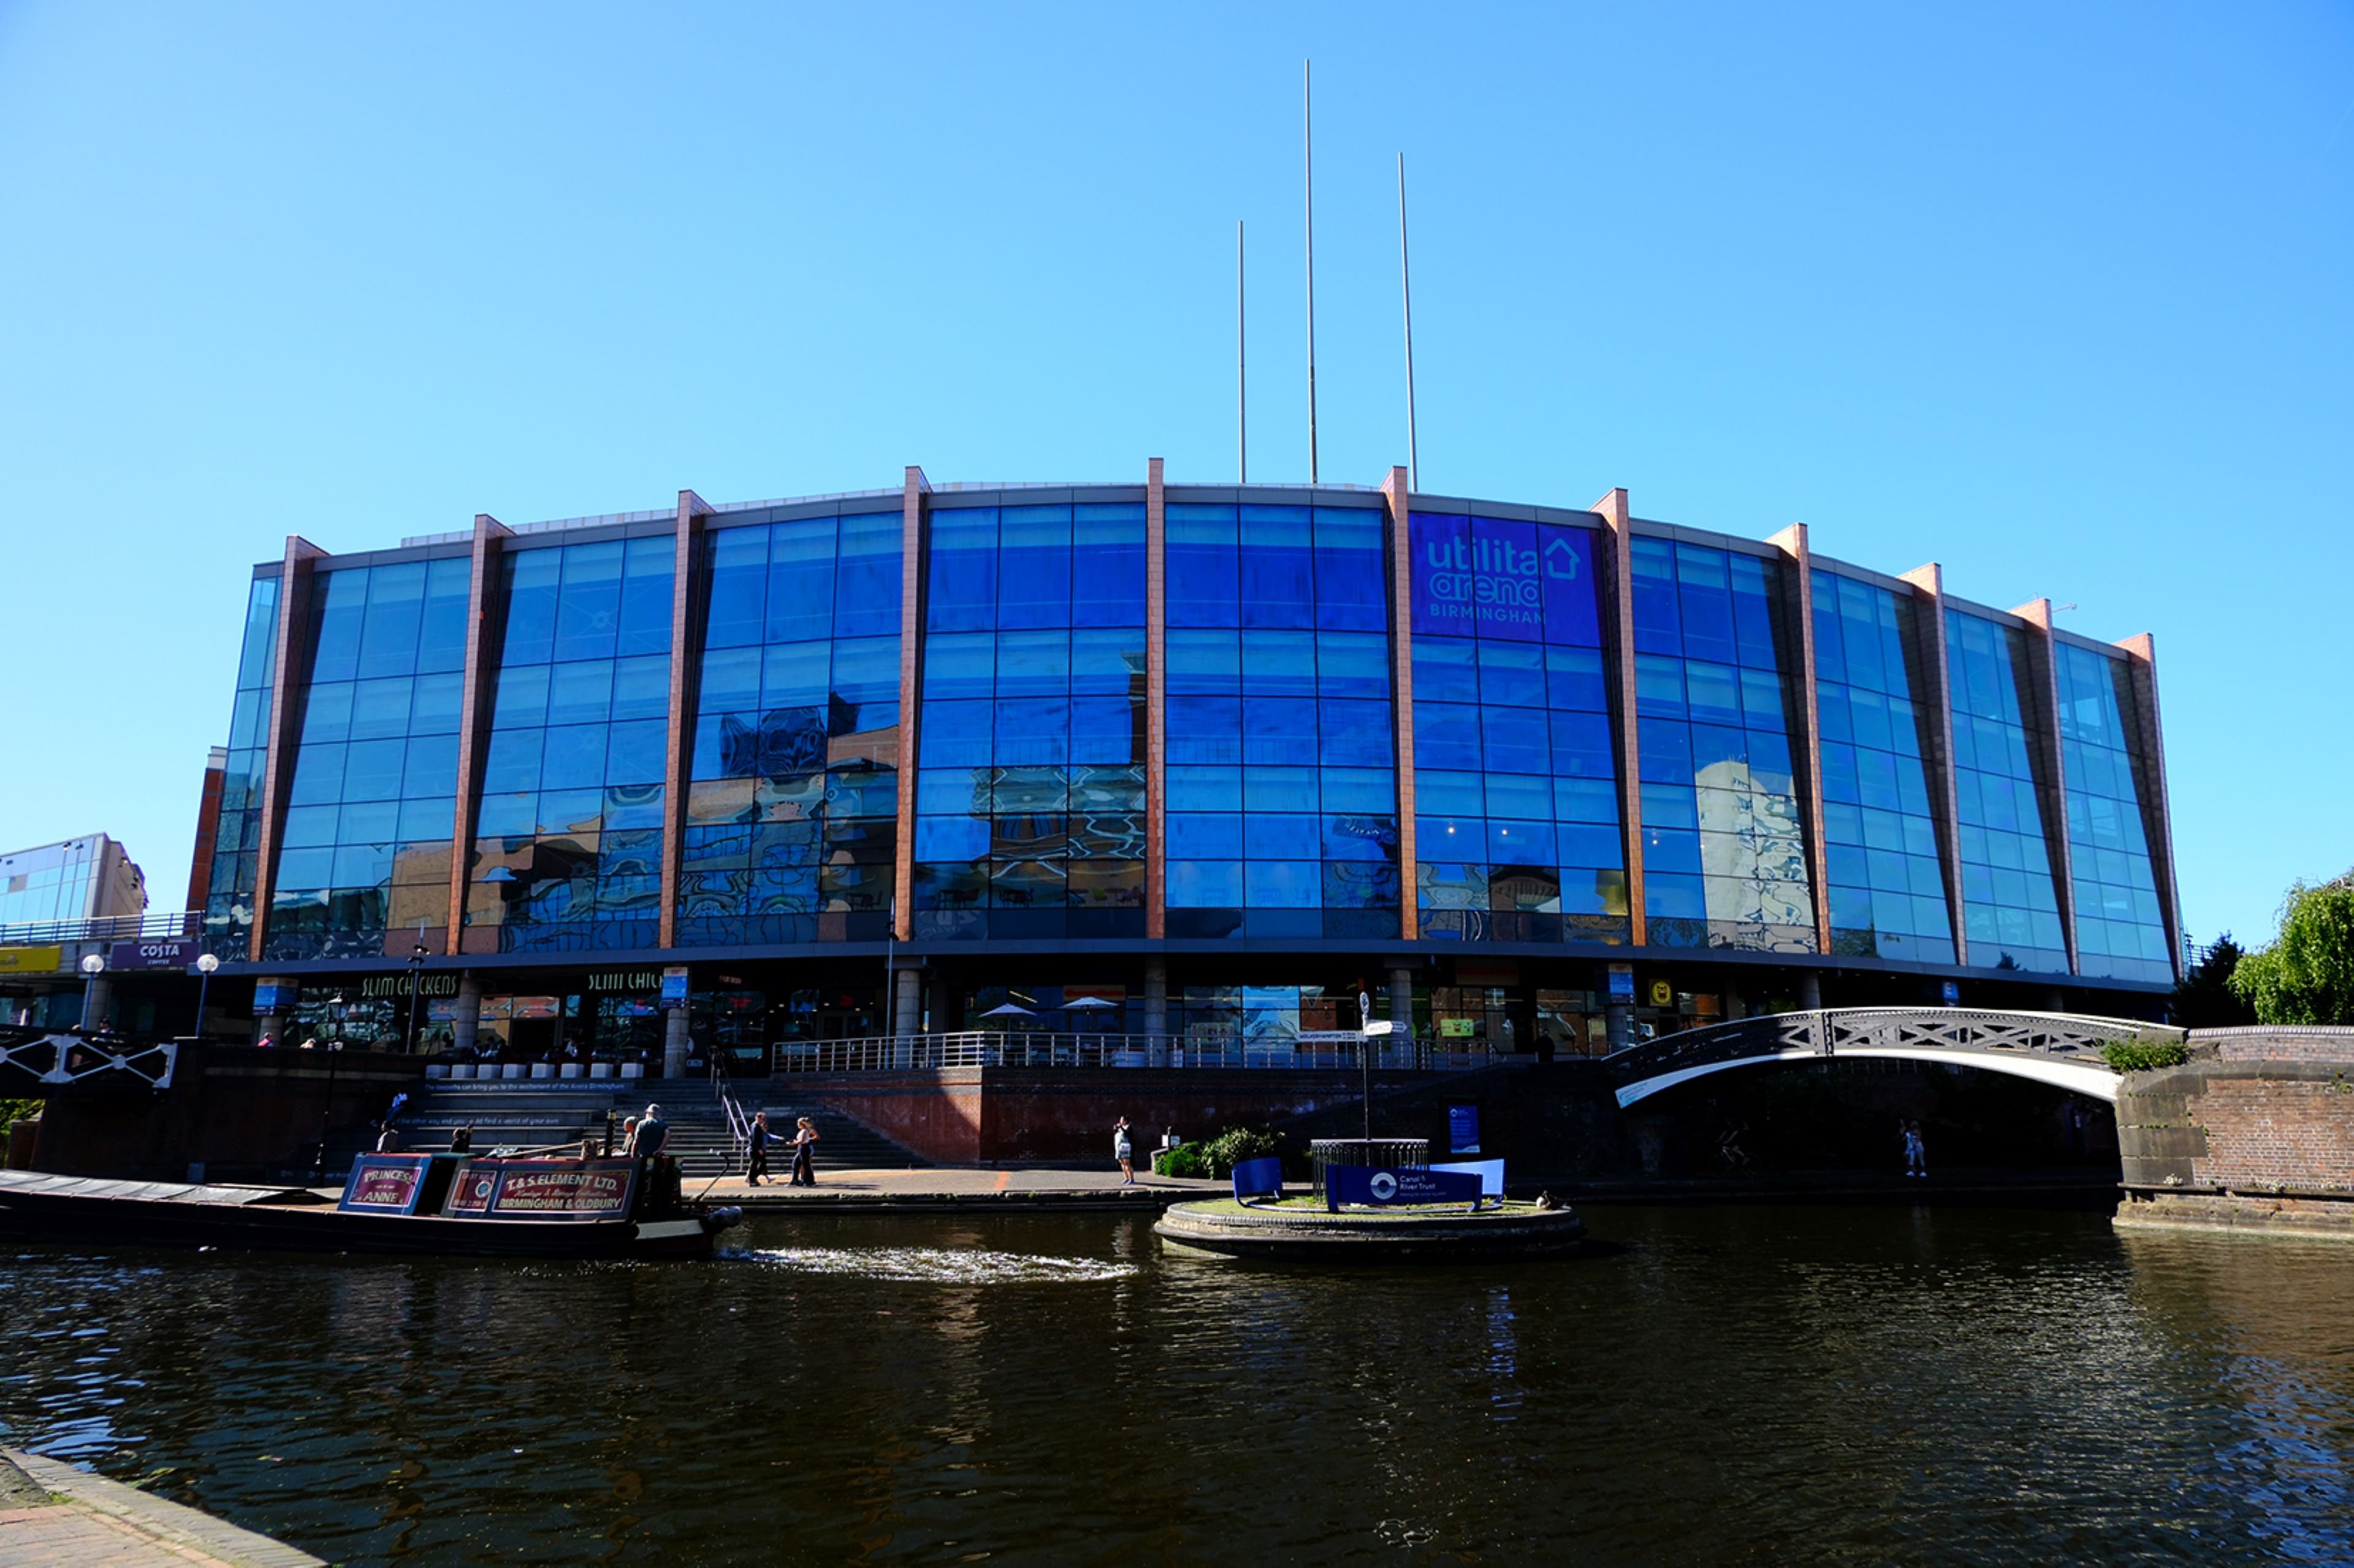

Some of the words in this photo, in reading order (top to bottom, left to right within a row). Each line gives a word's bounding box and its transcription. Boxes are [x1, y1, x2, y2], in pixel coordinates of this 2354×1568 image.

[1427, 535, 1542, 577] utilita
[1430, 571, 1544, 607] arena
[1430, 603, 1546, 625] BIRMINGHAM
[140, 945, 180, 958] COSTA
[362, 976, 395, 997] SLIM
[398, 975, 457, 995] CHCKENS
[1945, 982, 1952, 995] E
[537, 1174, 593, 1186] ELEMENT
[593, 1176, 618, 1191] LTD.
[363, 1191, 399, 1203] ANNE
[498, 1197, 563, 1208] BIRMINGHAM
[565, 1198, 573, 1209] &
[575, 1197, 622, 1208] OLDBURY
